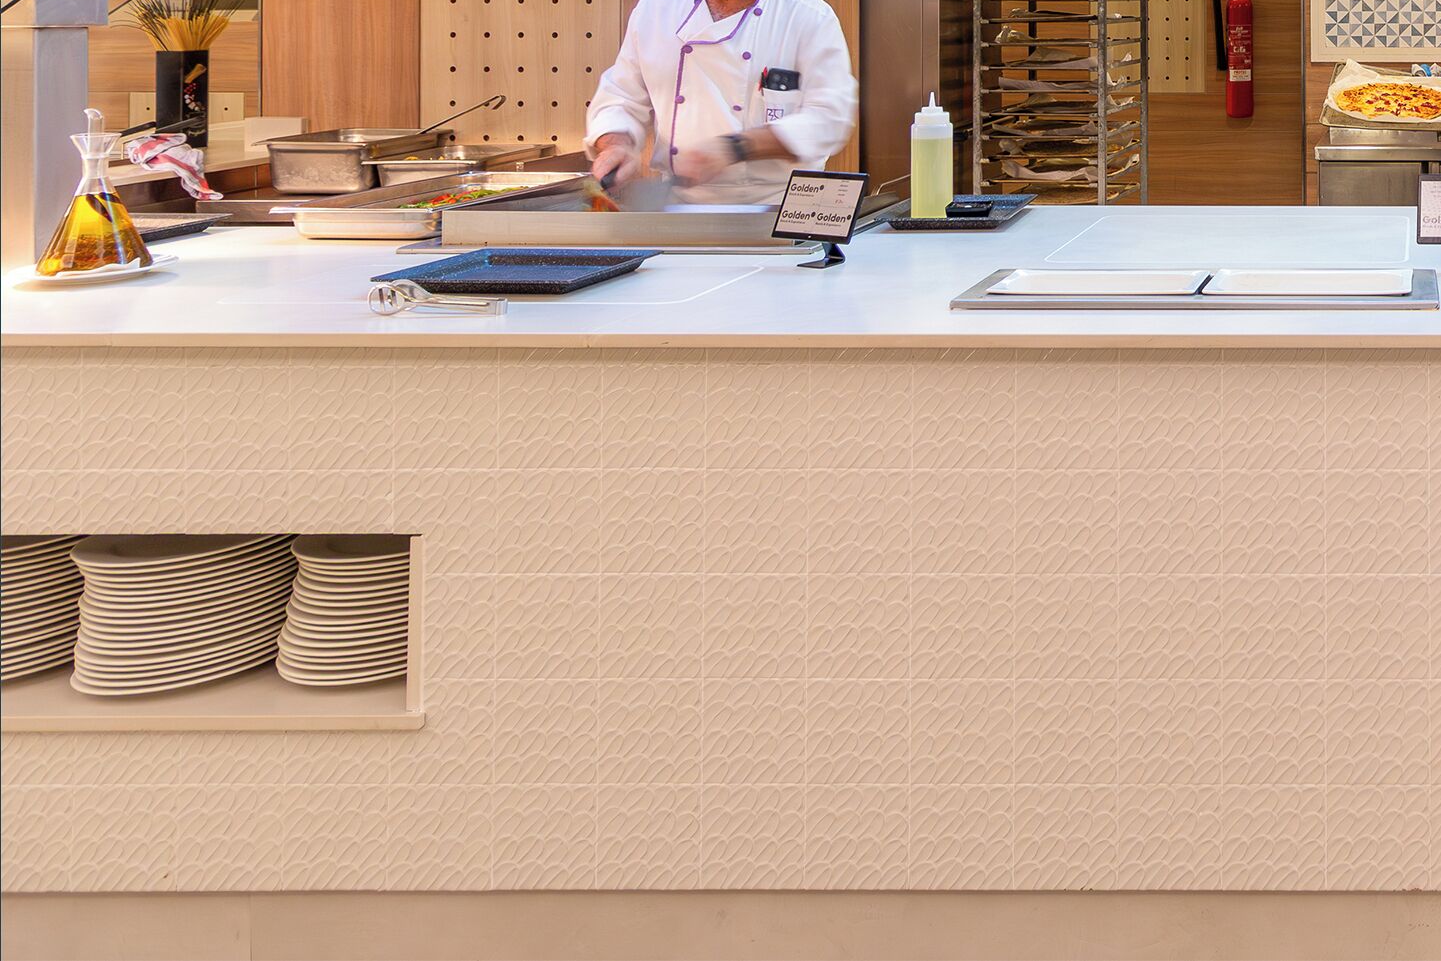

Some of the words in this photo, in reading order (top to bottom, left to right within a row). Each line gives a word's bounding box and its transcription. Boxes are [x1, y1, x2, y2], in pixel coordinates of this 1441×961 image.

[790, 183, 819, 193] Golden
[781, 210, 810, 220] Golden
[816, 213, 847, 223] Golden
